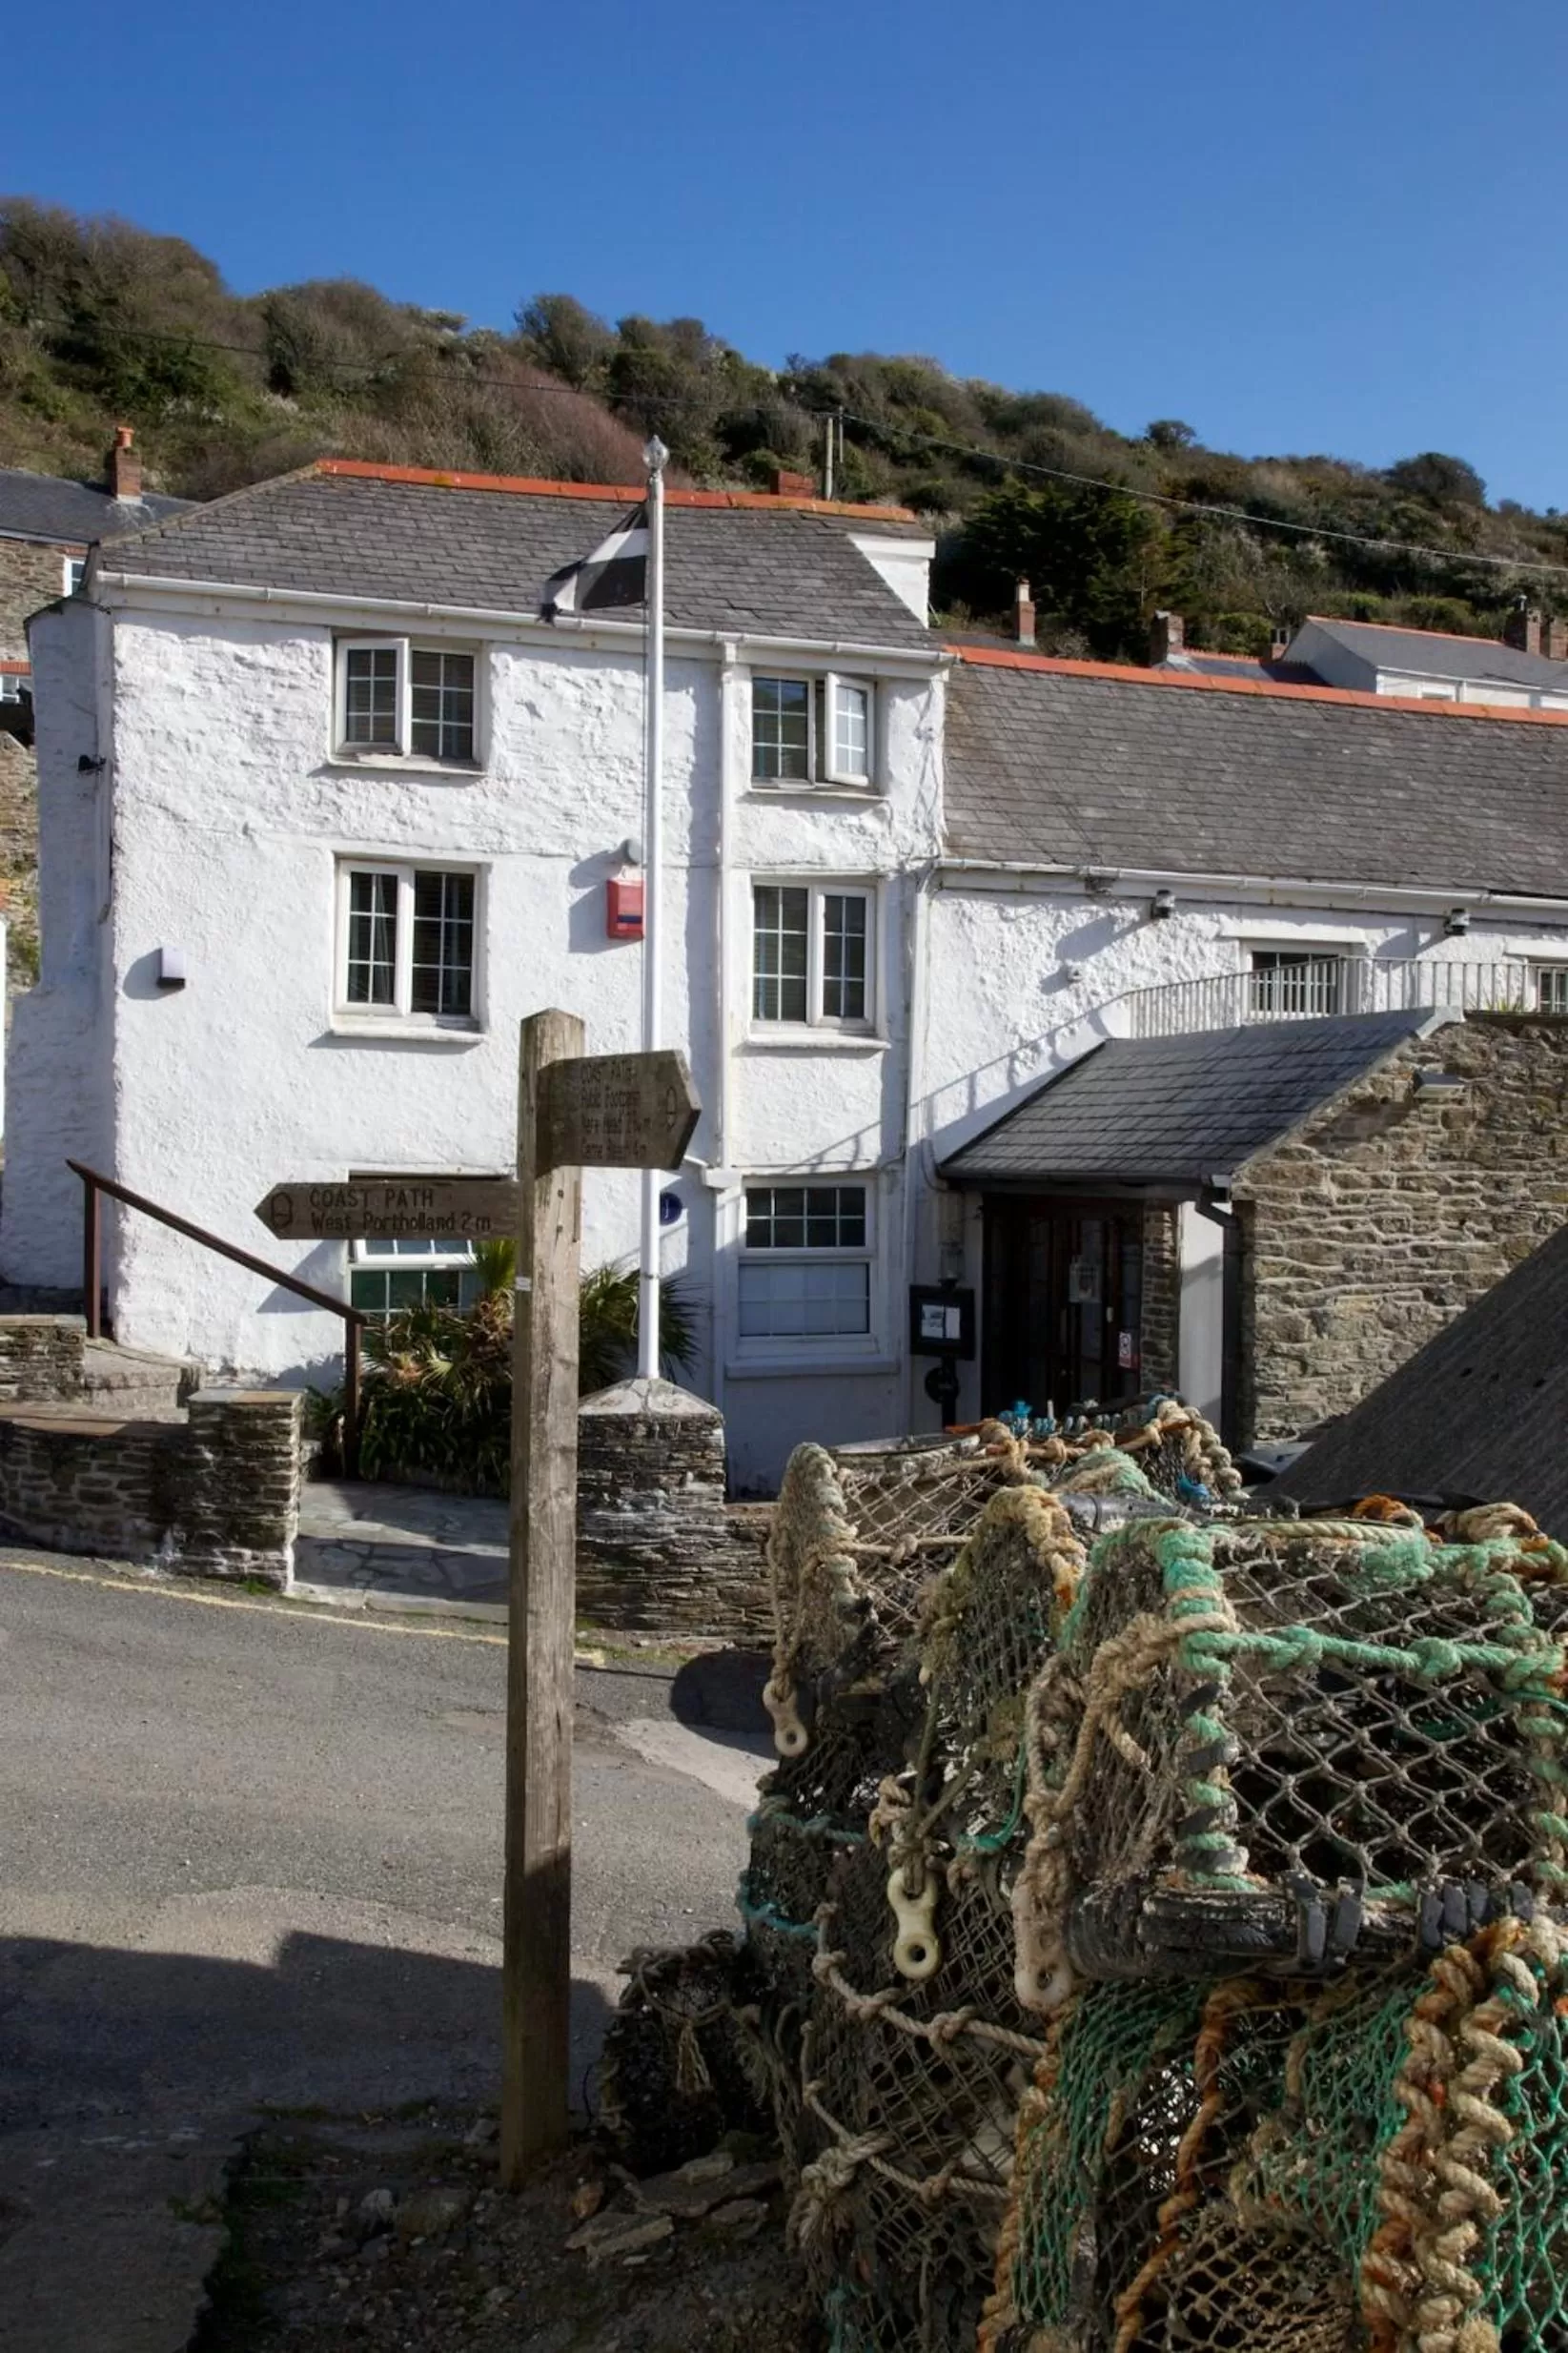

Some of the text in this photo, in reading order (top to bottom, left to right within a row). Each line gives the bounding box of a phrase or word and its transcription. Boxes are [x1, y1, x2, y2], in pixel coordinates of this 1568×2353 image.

[309, 1188, 435, 1209] COAST PATH
[310, 1212, 352, 1232] West
[363, 1212, 456, 1233] Portholland
